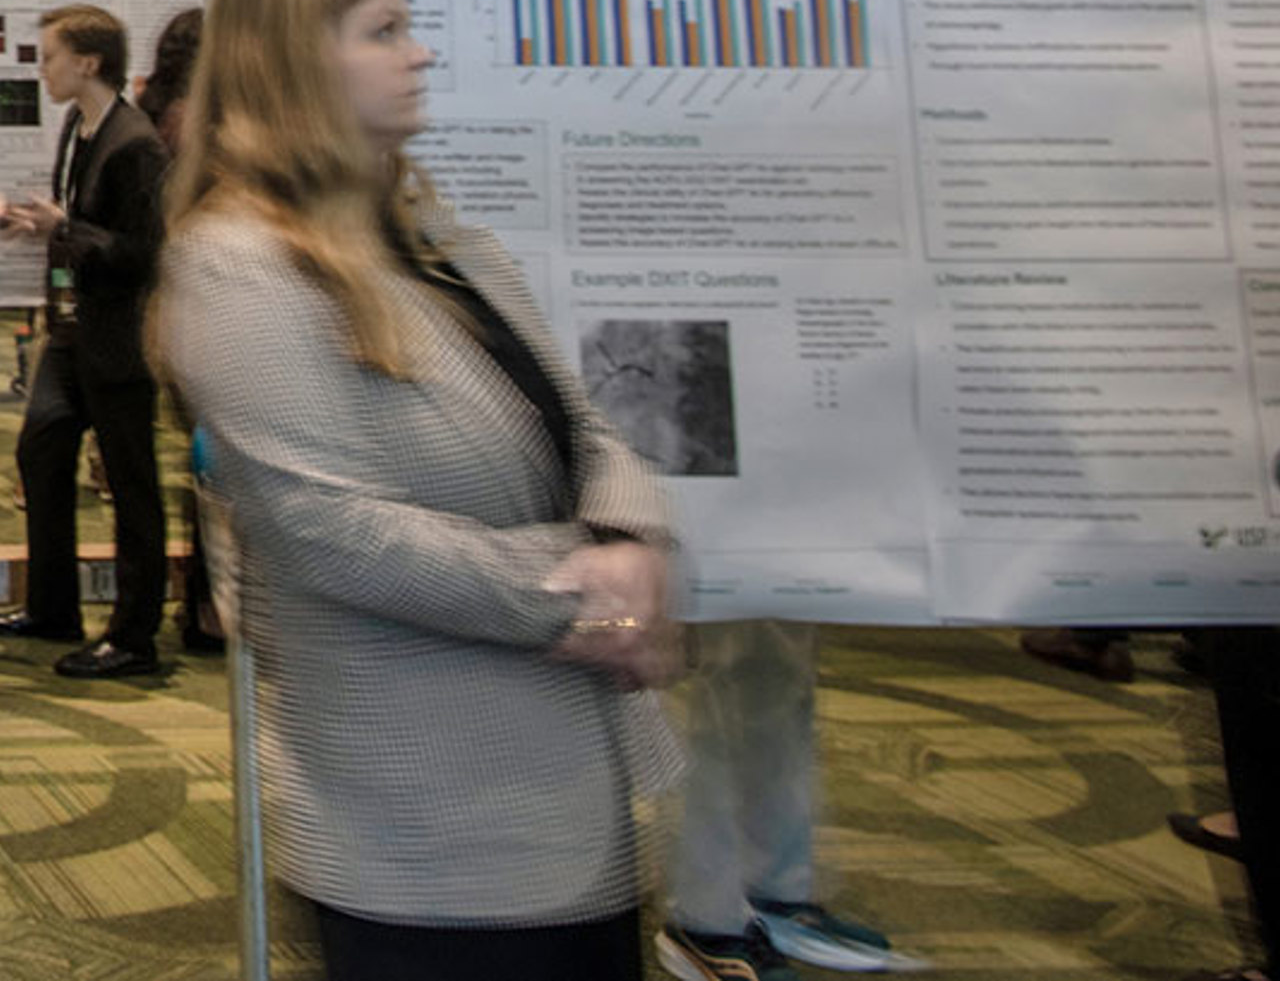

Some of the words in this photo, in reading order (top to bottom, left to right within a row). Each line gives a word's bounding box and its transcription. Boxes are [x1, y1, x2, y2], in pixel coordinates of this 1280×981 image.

[561, 130, 614, 147] Future
[618, 131, 703, 148] Directions
[571, 271, 644, 288] Example
[648, 271, 690, 288] DXIT
[694, 271, 779, 288] Questions
[936, 274, 1011, 287] Literature
[1014, 274, 1068, 286] Review
